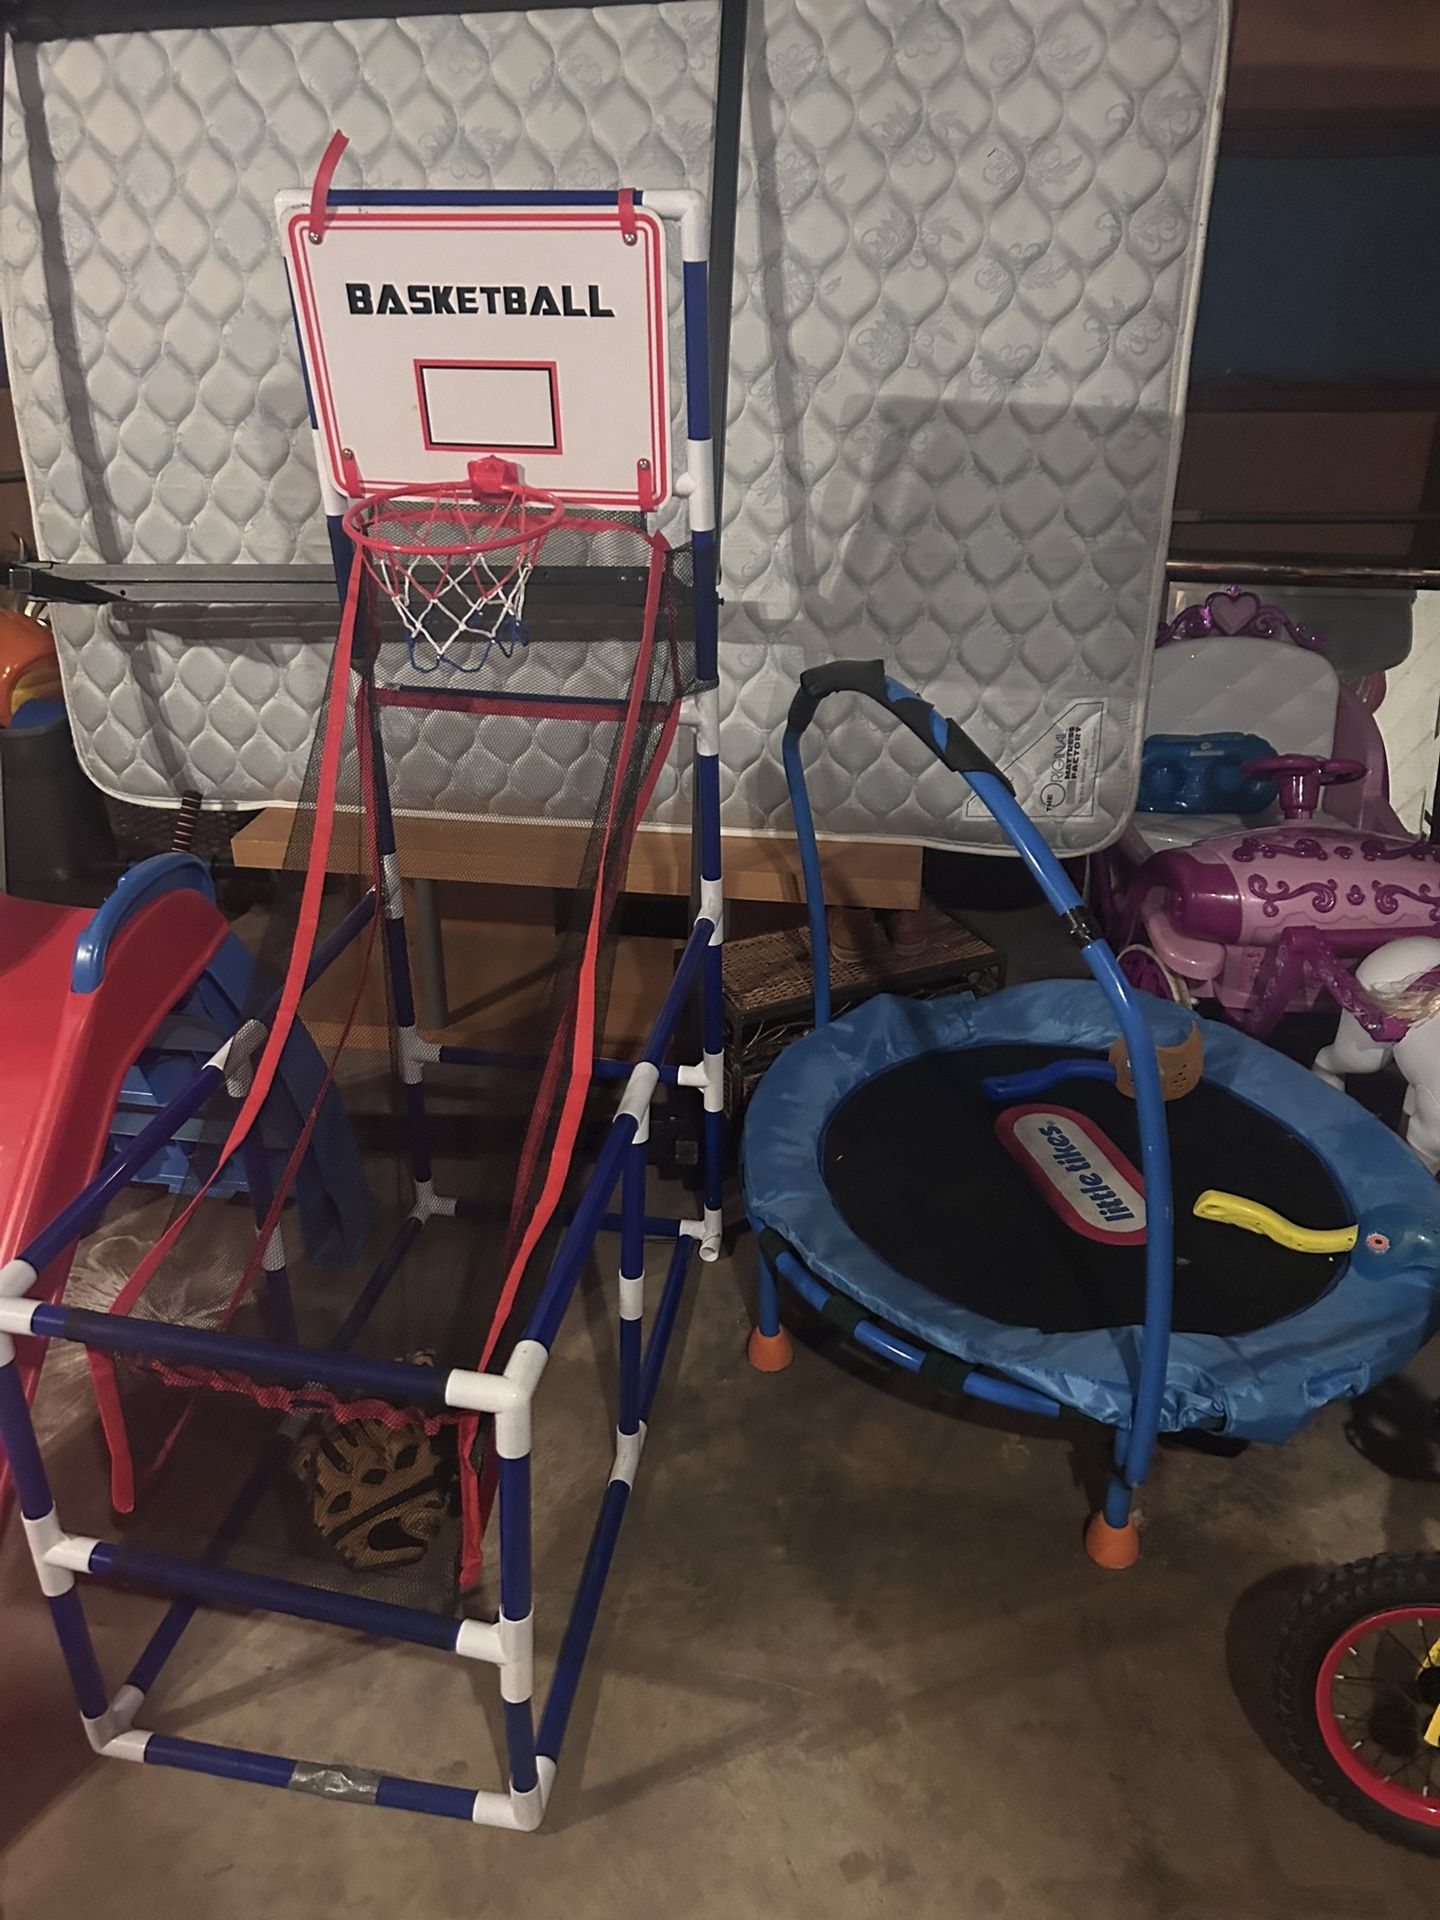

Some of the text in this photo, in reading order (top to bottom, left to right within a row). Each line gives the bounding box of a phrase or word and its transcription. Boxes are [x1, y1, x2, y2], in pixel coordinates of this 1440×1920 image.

[345, 282, 616, 318] BASKETBALL
[1040, 730, 1066, 808] ORIGINAL
[1064, 726, 1075, 780] MATTRESS
[1071, 726, 1081, 780] FACTORY
[1038, 1124, 1135, 1222] little tikes
